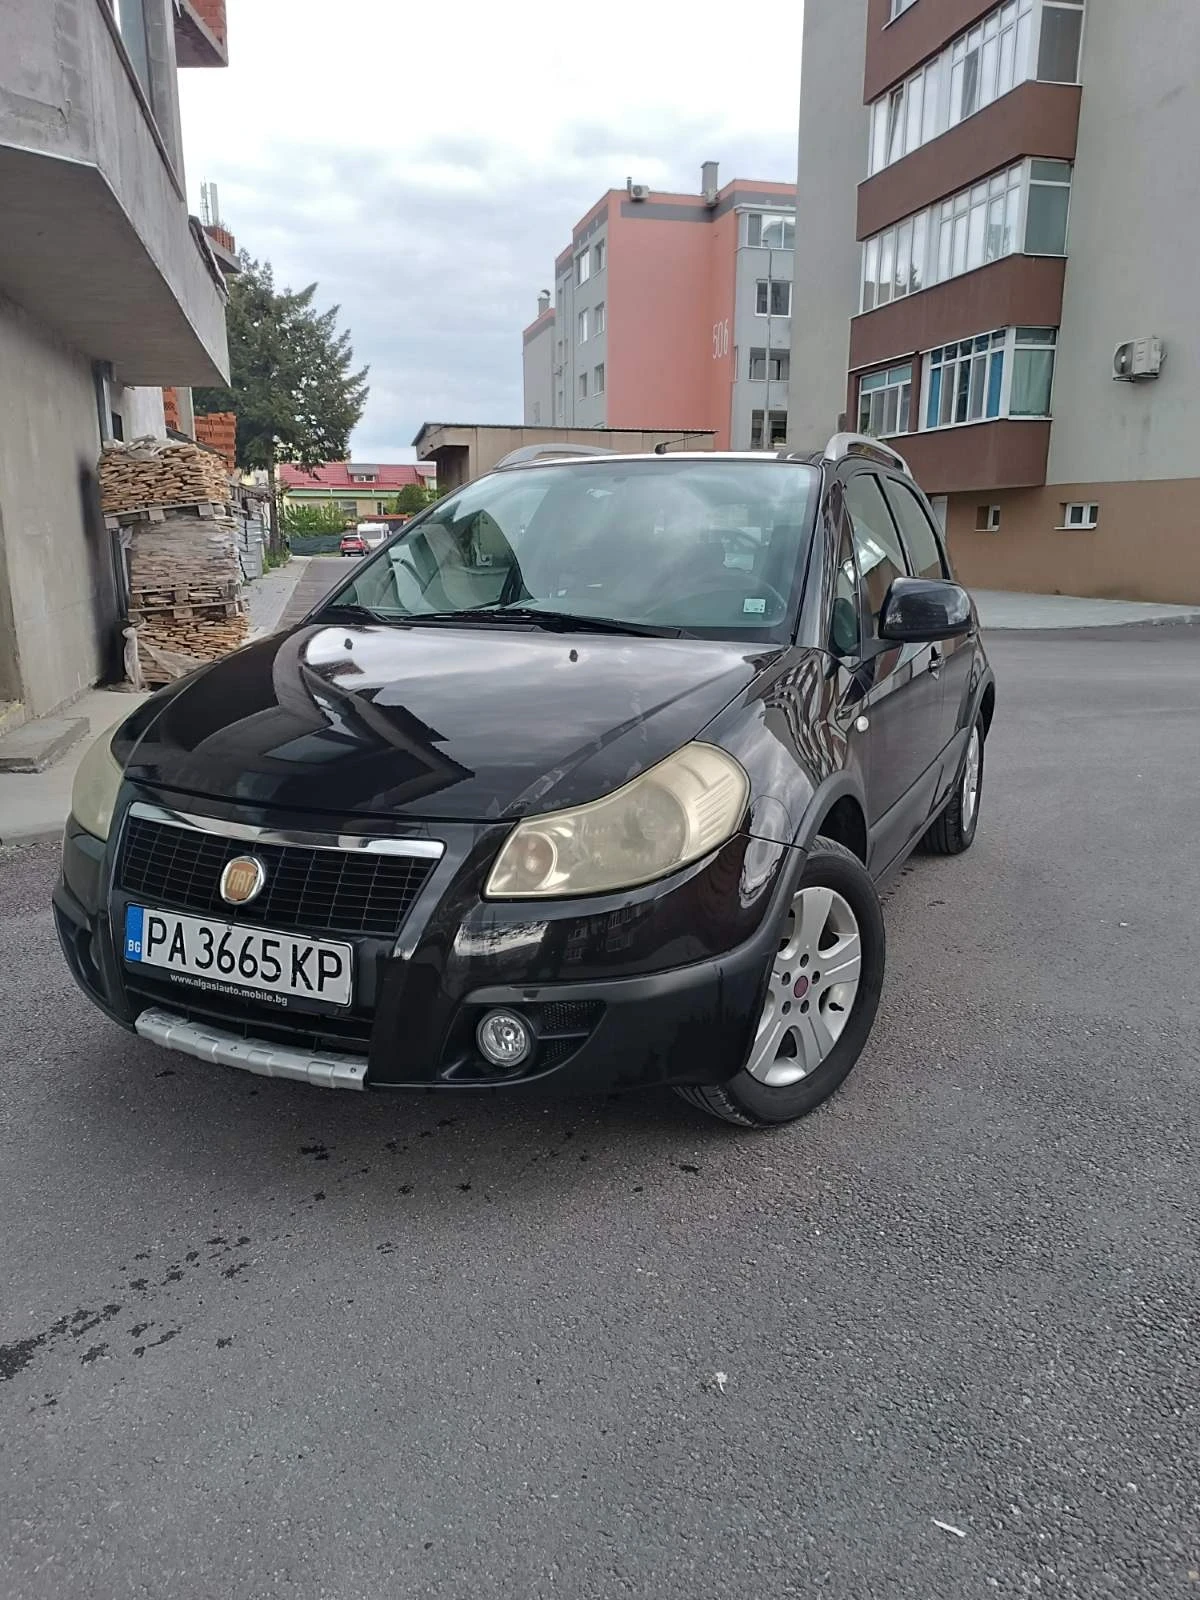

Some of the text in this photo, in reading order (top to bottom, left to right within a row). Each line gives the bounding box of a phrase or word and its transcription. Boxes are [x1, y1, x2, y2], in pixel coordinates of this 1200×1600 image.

[712, 318, 728, 360] 506
[227, 869, 256, 892] FIAT
[128, 940, 141, 953] BG
